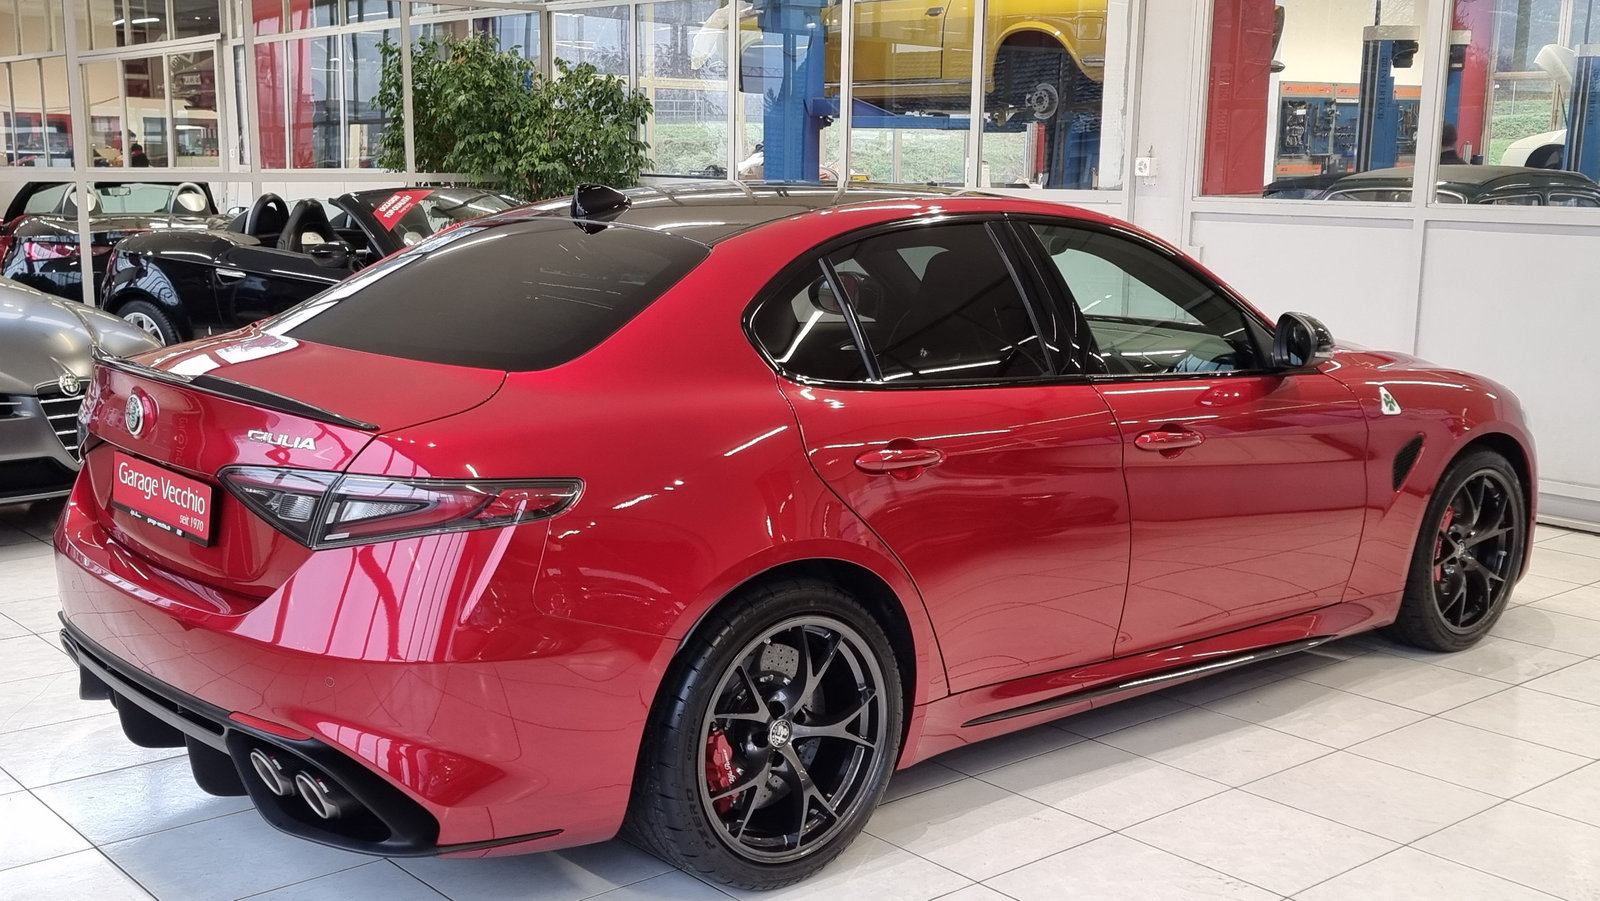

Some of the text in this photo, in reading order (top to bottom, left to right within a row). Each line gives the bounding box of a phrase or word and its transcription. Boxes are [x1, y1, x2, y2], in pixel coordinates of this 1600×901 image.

[247, 429, 317, 451] GIULIA
[118, 462, 206, 515] Garage Vecchio
[180, 514, 189, 527] seit
[190, 517, 204, 532] 1970
